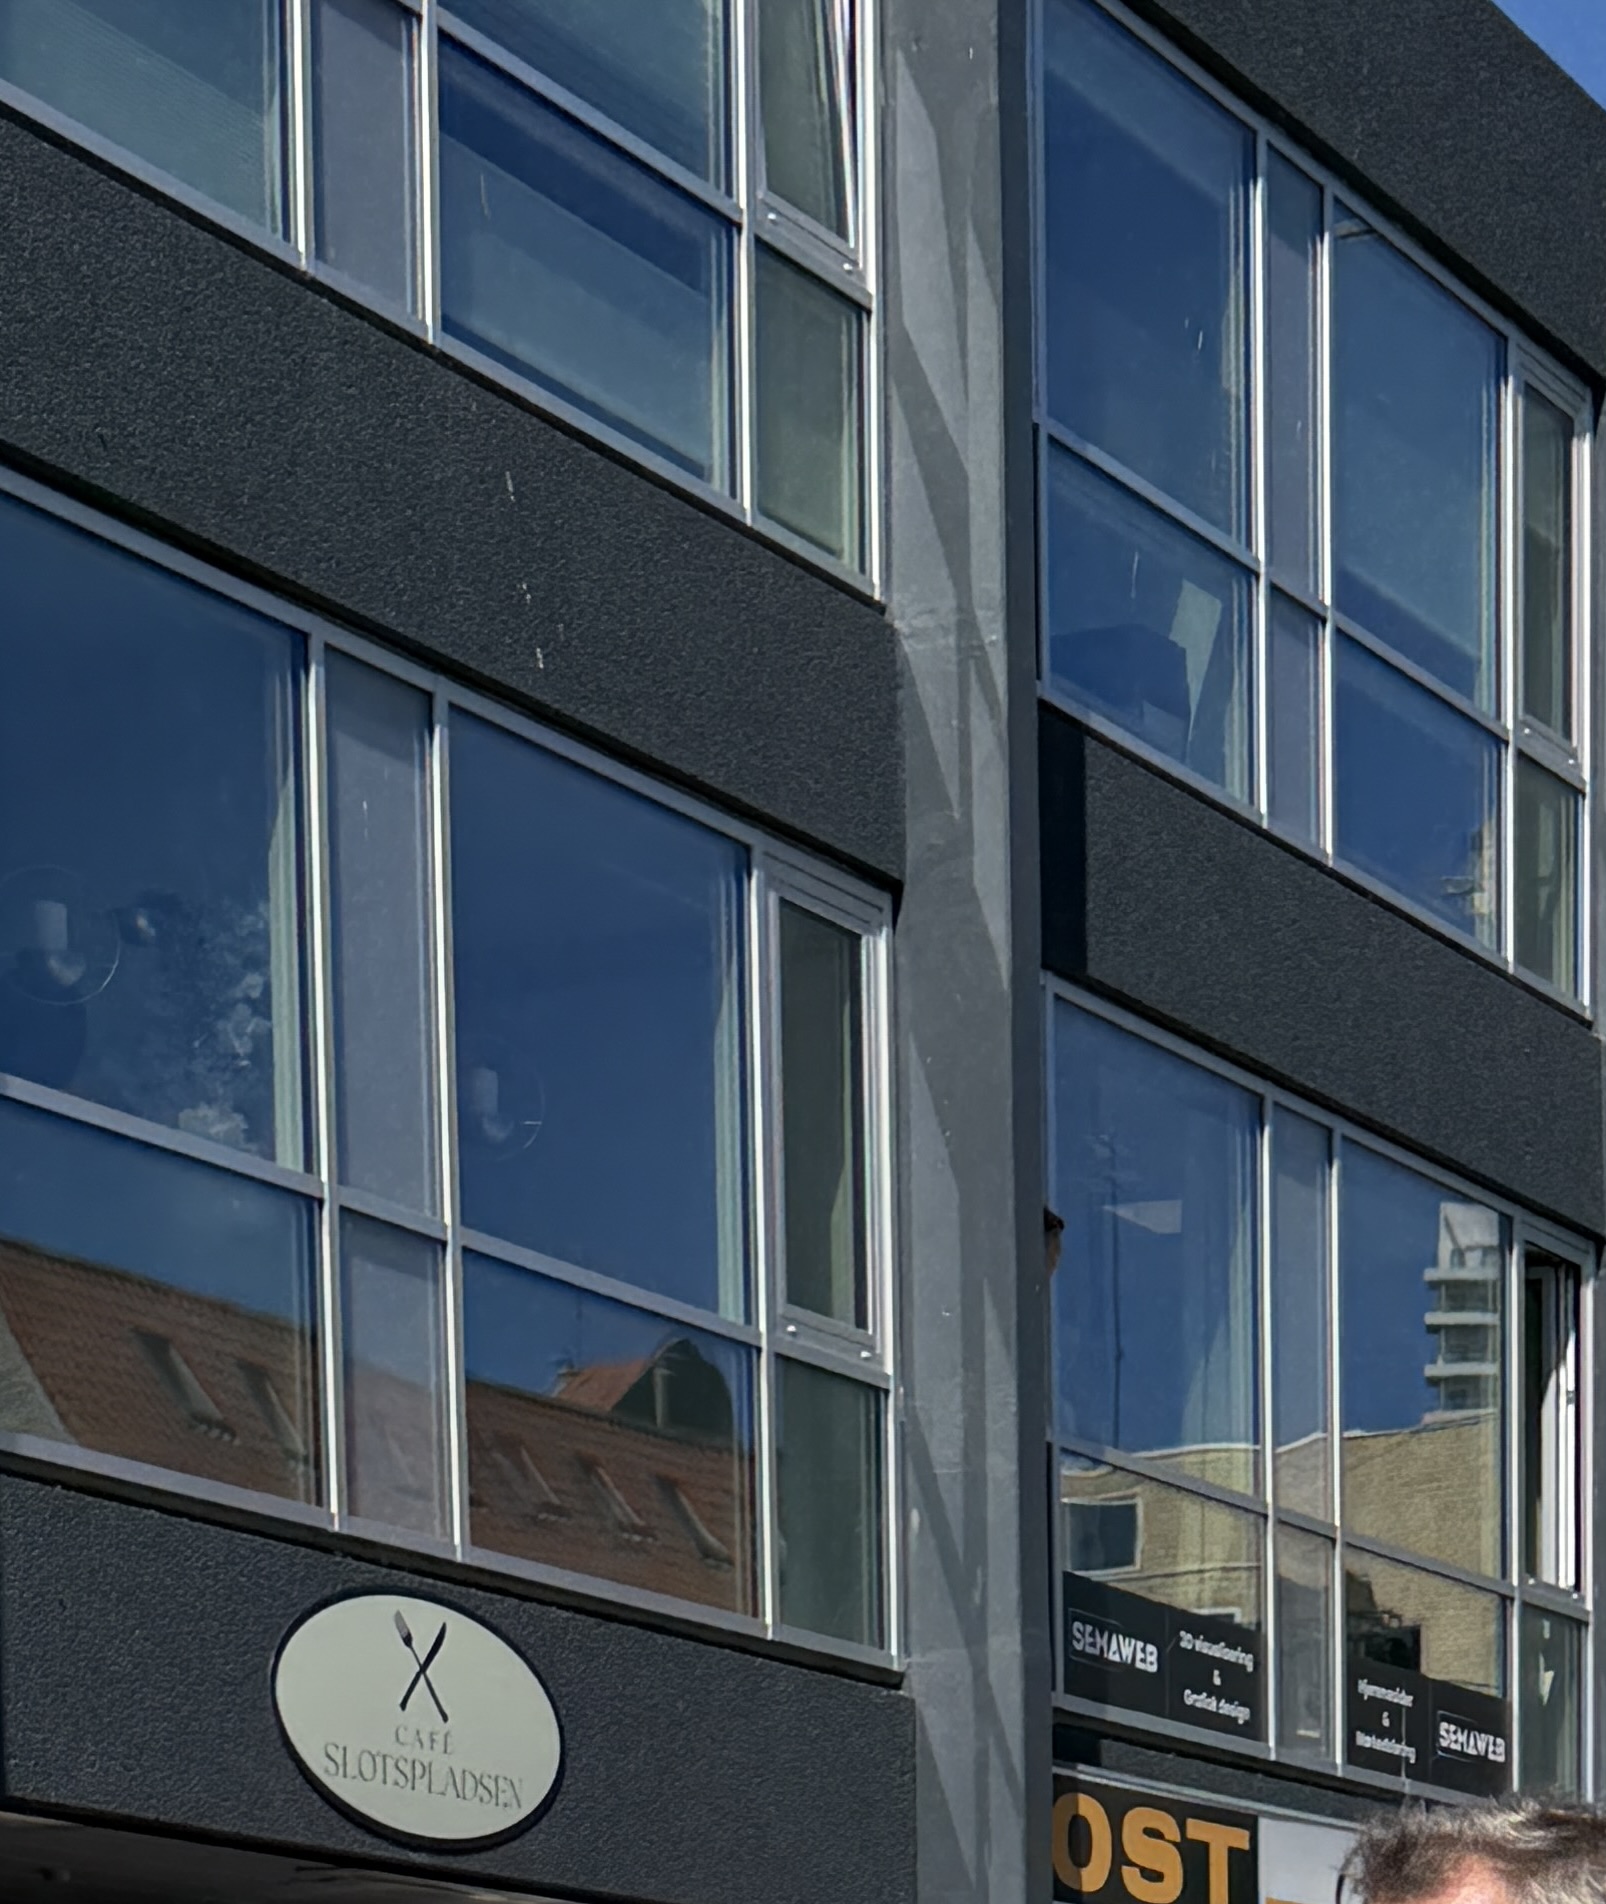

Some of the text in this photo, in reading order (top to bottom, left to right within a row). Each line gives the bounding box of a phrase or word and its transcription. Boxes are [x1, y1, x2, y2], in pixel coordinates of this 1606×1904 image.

[1072, 1621, 1158, 1673] SEMAWEB
[1439, 1721, 1506, 1763] SEMAWEB
[323, 1741, 523, 1809] SLOTSPLADSEN
